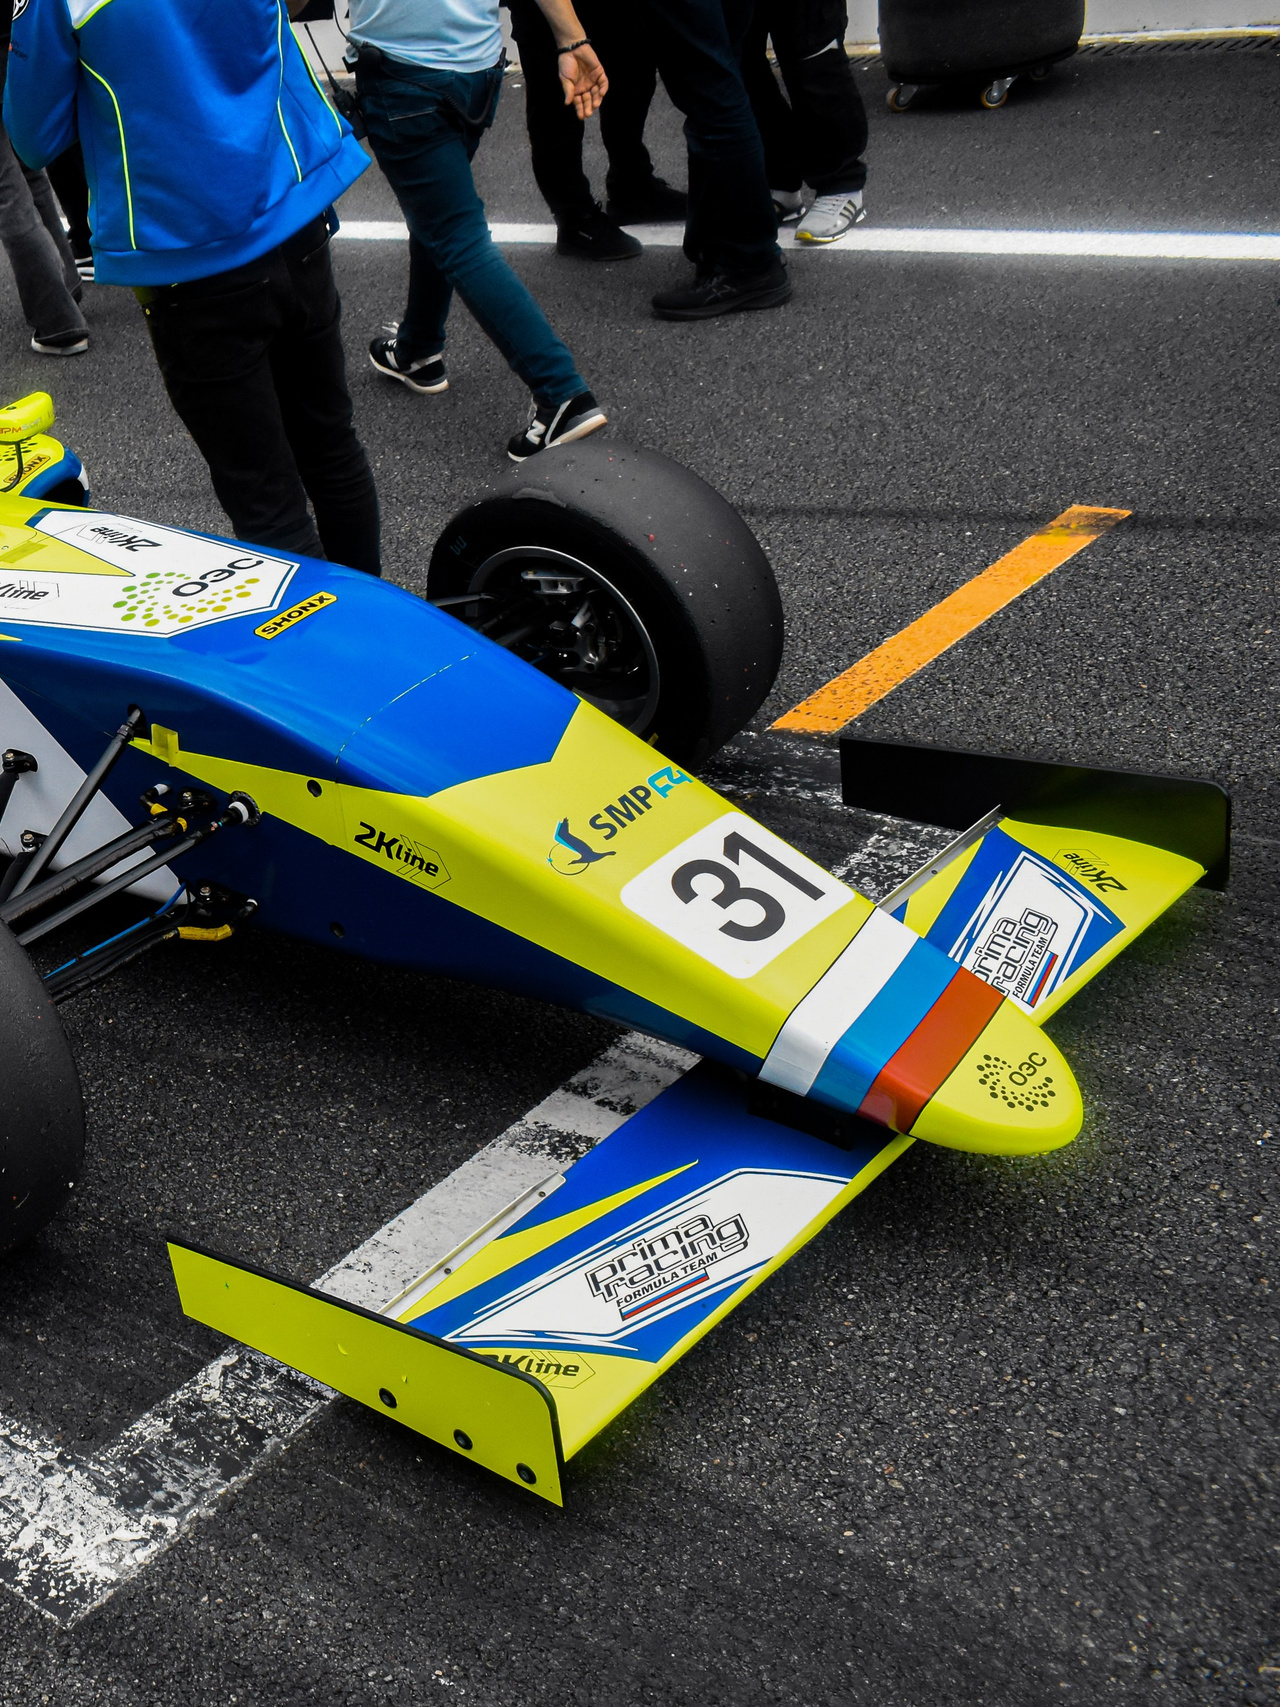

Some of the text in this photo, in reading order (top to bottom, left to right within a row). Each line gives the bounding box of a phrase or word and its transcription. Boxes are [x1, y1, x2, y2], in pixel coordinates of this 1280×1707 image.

[91, 527, 163, 553] 2Kline
[261, 592, 332, 635] SHONX
[354, 821, 439, 878] 2Kline
[1063, 852, 1128, 893] 2Kline
[671, 831, 826, 942] 31
[1013, 937, 1047, 997] FORMULA TEAM
[586, 1215, 712, 1296] prima
[605, 1214, 749, 1302] racing
[616, 1252, 718, 1307] FORMULA TEAM
